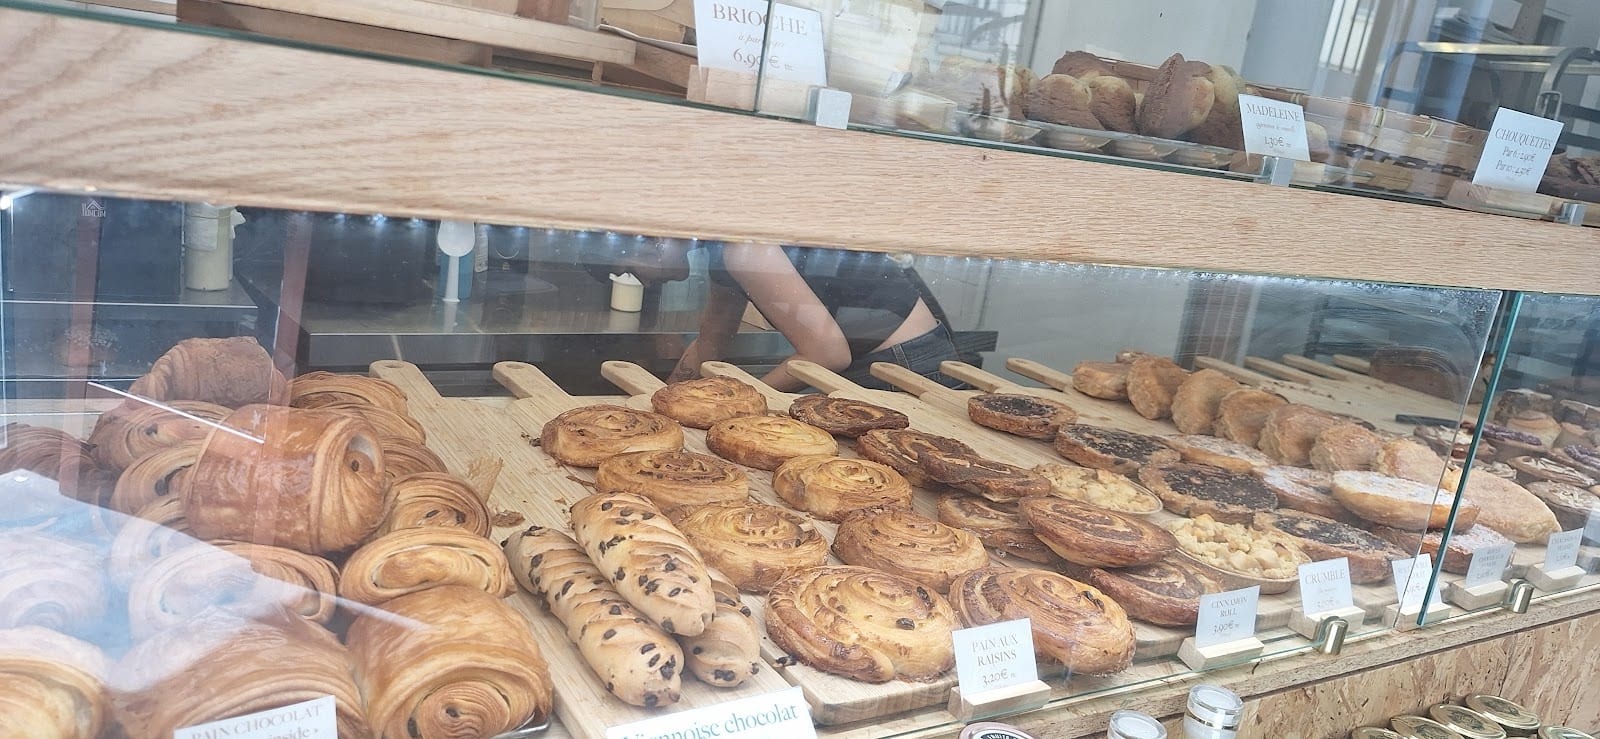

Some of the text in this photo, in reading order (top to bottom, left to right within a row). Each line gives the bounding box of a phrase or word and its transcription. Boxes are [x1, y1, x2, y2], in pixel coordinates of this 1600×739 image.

[1247, 104, 1300, 121] MADELEINE
[1495, 128, 1552, 149] CHOUQUETTES
[1305, 568, 1346, 585] CRUMBLE
[972, 633, 1019, 652] PAIN AUX
[977, 649, 1017, 668] RAISINS
[233, 704, 321, 736] CHOCOLAT
[621, 703, 799, 739] noise chocolat
